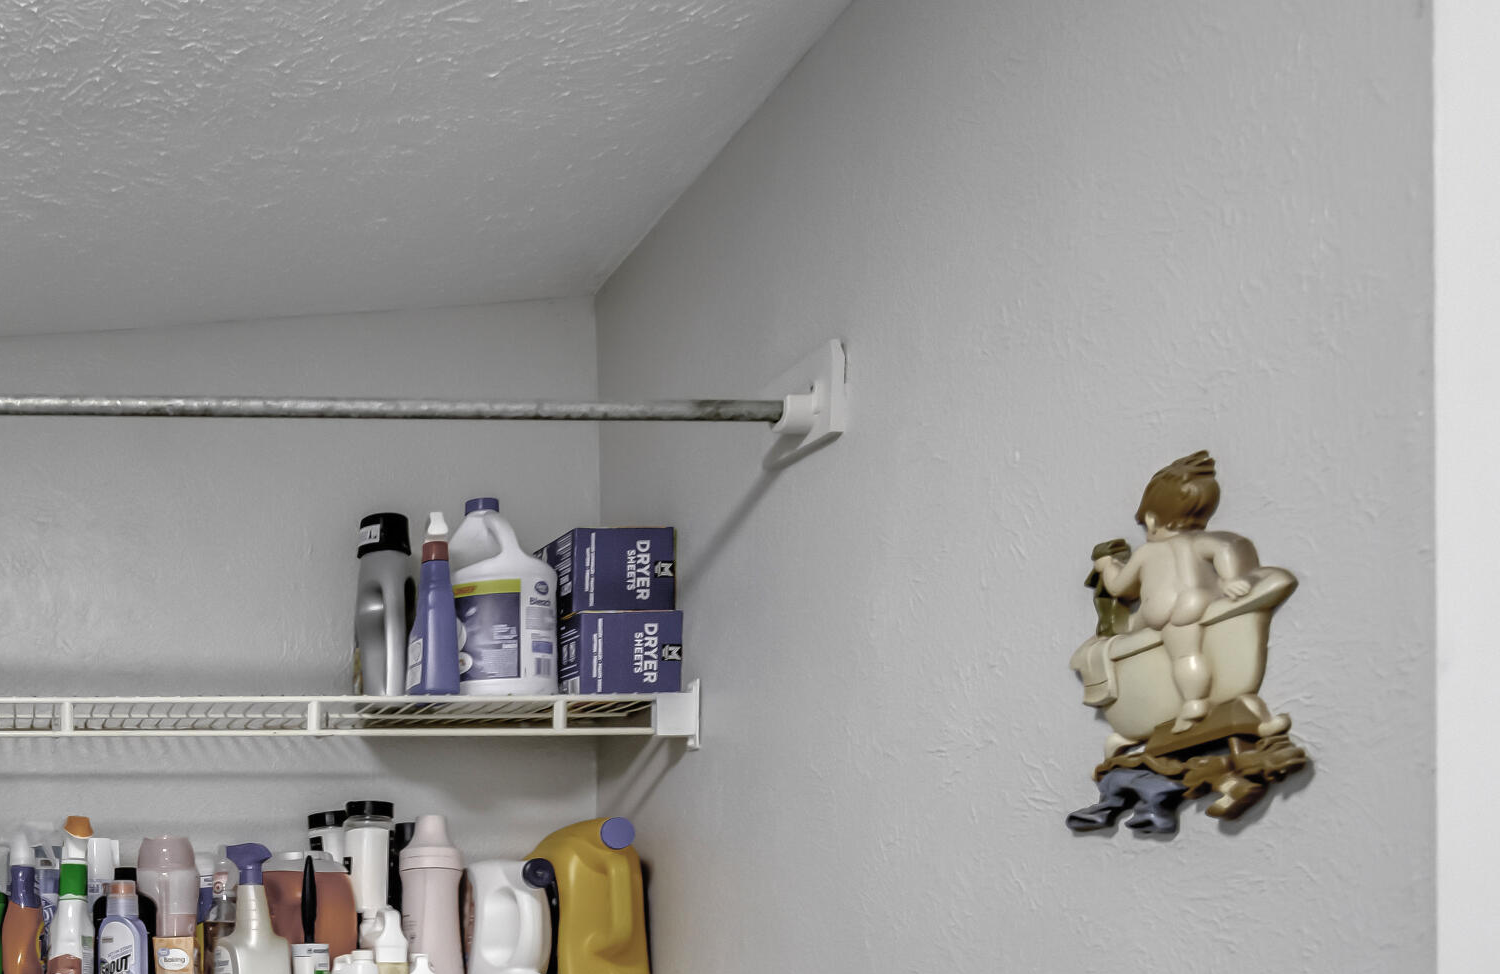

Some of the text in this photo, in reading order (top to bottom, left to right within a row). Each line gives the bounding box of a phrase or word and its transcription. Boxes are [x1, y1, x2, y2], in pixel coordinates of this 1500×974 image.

[626, 549, 636, 591] SHEETS
[636, 540, 651, 601] DRYER
[633, 632, 644, 674] SHEETS
[643, 623, 659, 683] DRYER
